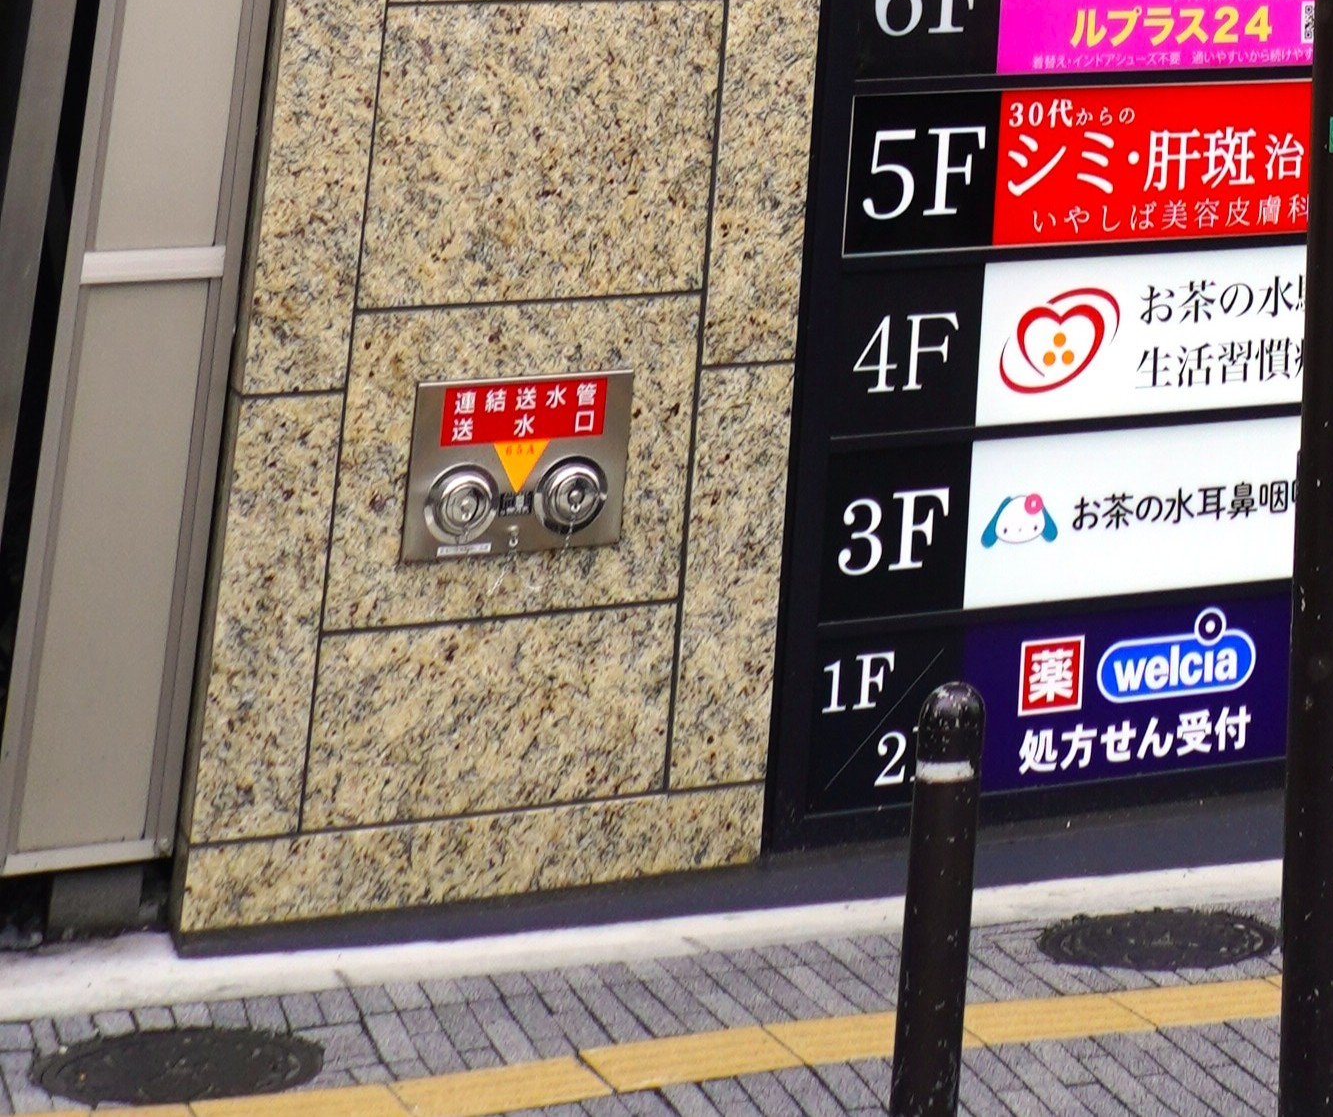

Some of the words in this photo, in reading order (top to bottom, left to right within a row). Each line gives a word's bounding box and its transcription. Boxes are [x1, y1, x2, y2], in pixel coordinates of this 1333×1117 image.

[1070, 5, 1273, 48] ルプラス24
[1008, 98, 1136, 128] 30代からの
[861, 125, 987, 220] 5F
[1032, 195, 1310, 234] いやしば美容皮膚科
[1139, 274, 1306, 325] お茶の水
[852, 311, 960, 394] 4F
[453, 382, 598, 416] 連結送水管
[836, 486, 951, 577] 3F
[821, 650, 896, 715] 1F
[1026, 647, 1075, 705] 薬
[1112, 643, 1239, 694] welcia
[873, 726, 919, 787] 2
[1017, 706, 1252, 777] 処方せん受付
